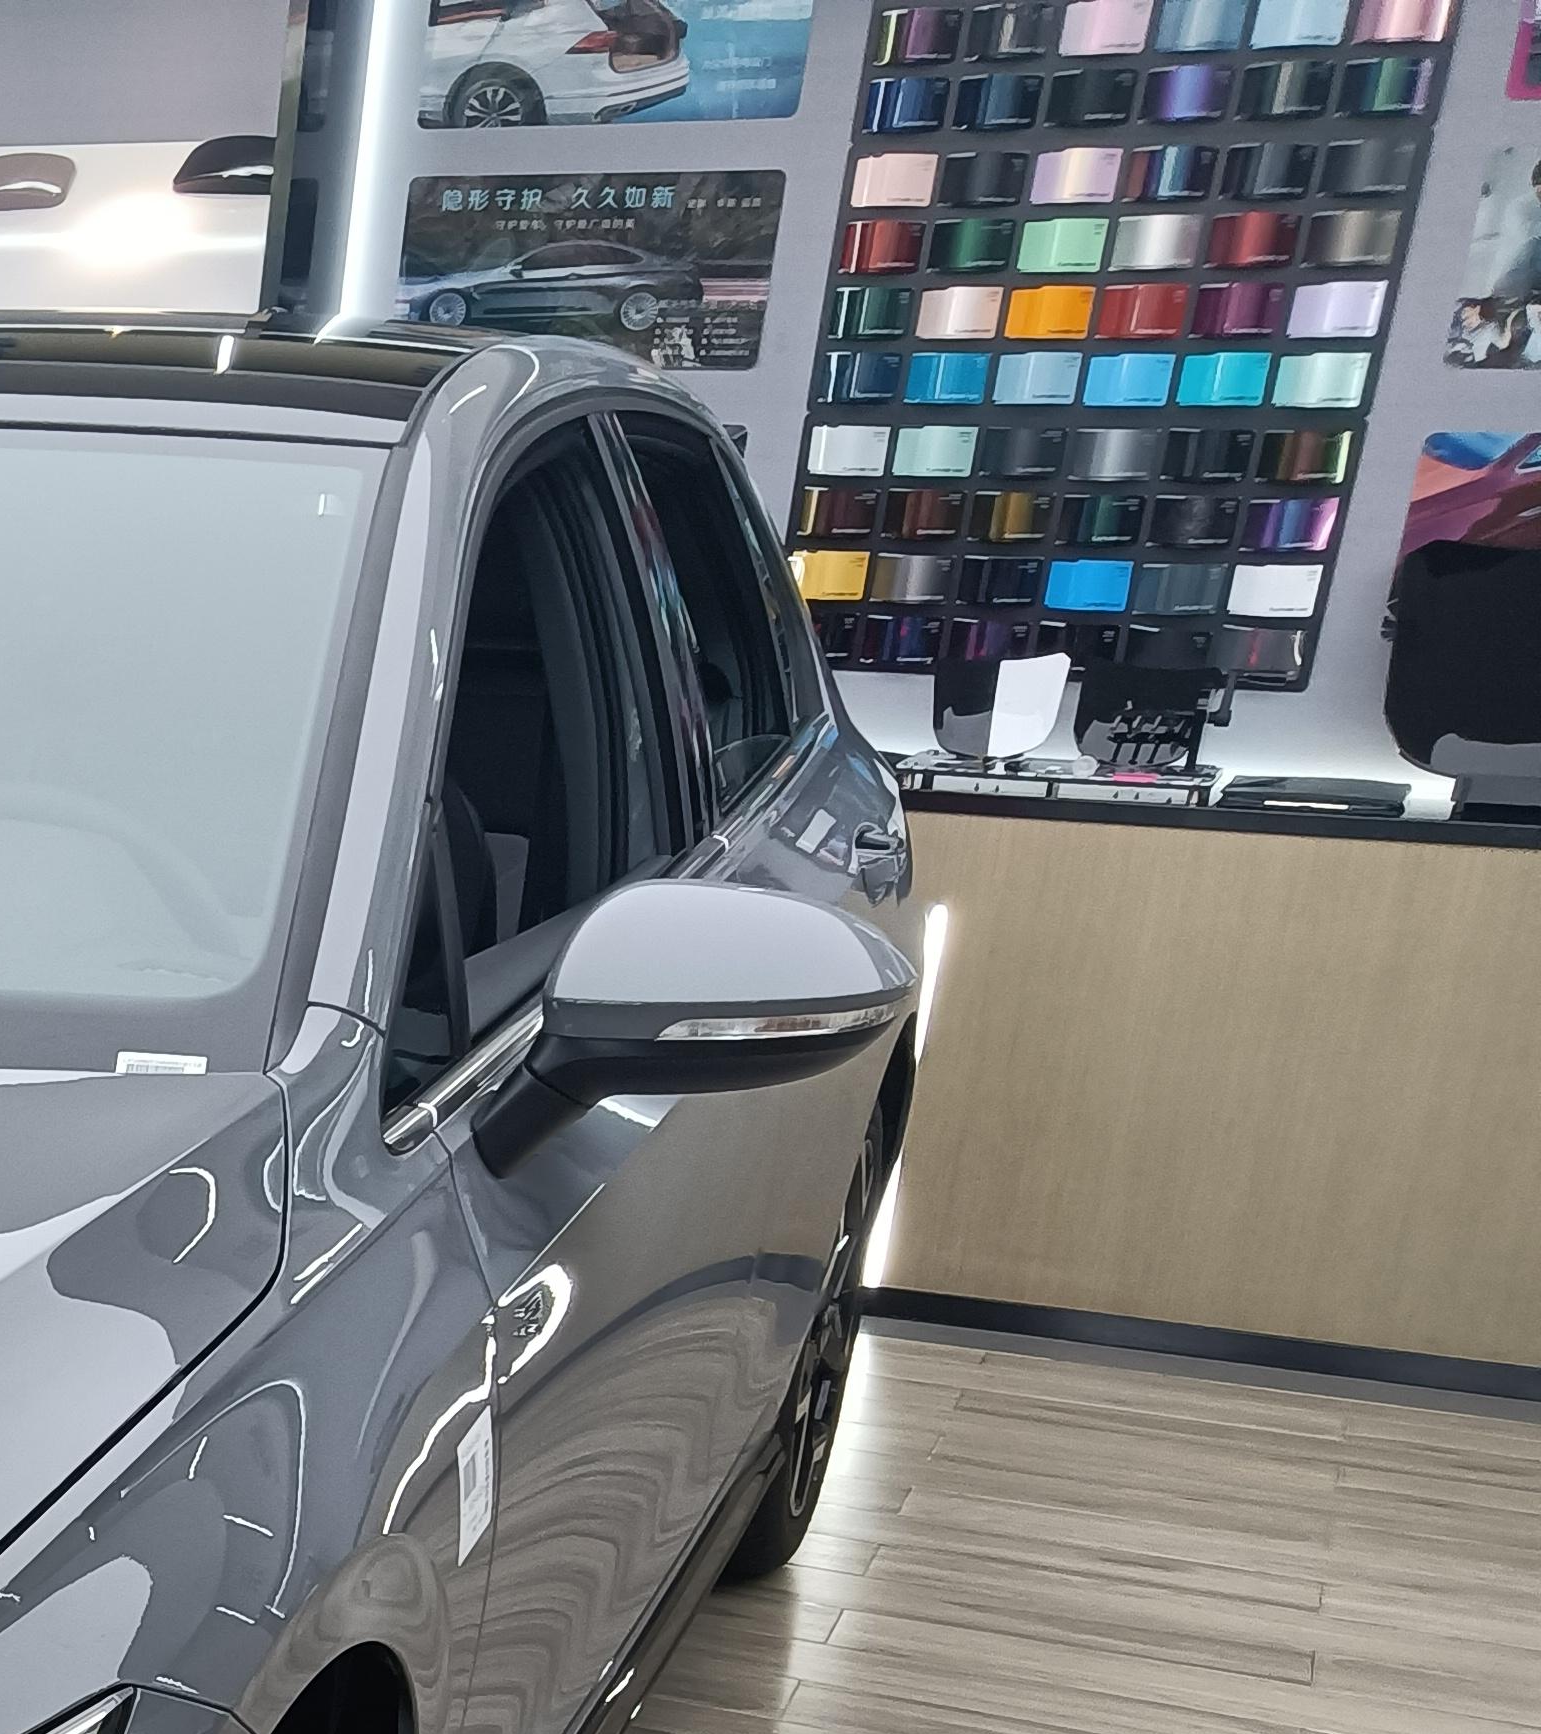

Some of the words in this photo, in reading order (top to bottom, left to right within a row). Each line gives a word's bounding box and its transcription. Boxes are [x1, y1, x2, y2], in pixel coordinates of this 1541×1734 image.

[442, 188, 542, 212] 隐形守护
[570, 186, 676, 209] 久久如新
